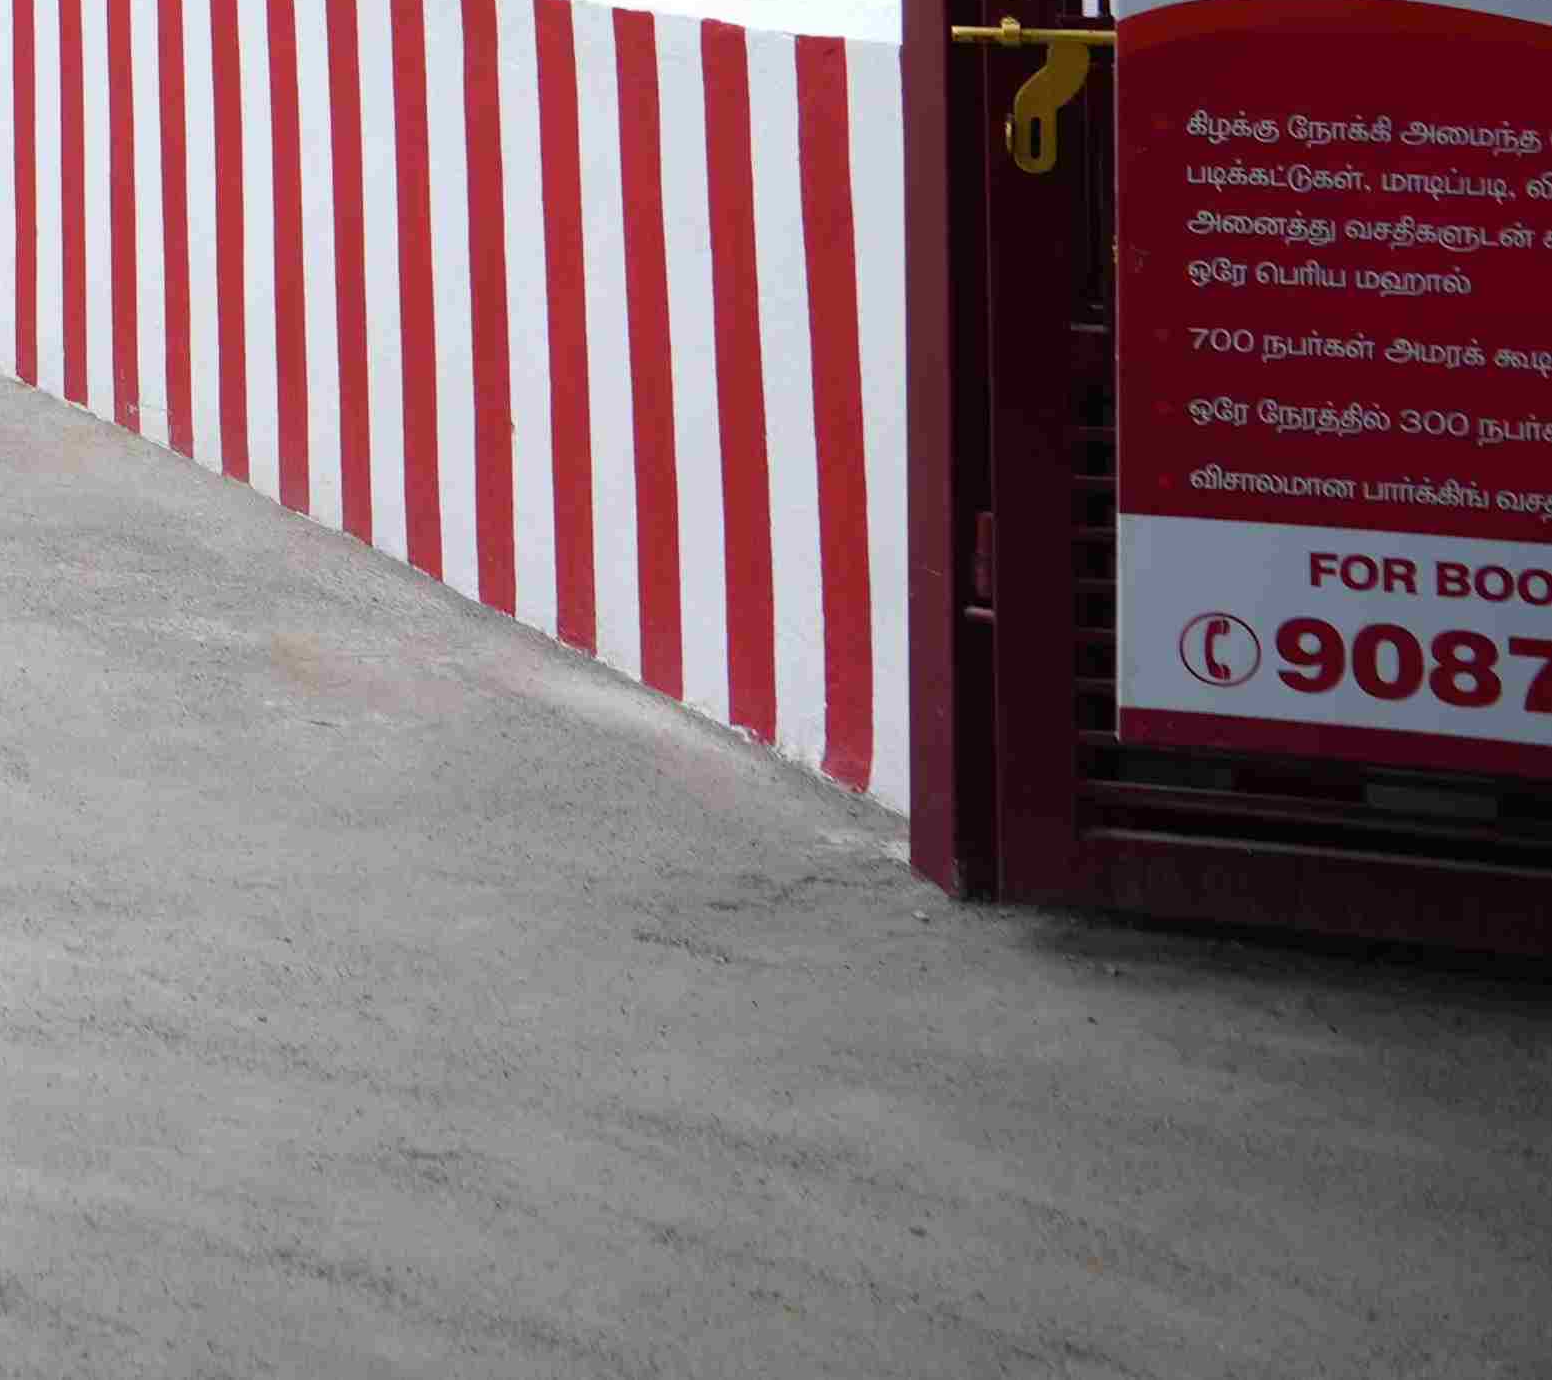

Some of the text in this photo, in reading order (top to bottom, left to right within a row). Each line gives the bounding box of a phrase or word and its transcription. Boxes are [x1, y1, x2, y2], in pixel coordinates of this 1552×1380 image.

[1186, 109, 1543, 158] கிழக்கு நோக்கி அமைந்த
[1186, 209, 1336, 246] அனைத்து
[1344, 215, 1536, 253] வசதிகளுடன்
[1187, 256, 1472, 298] ஒரே பெரிய மஹால்
[1188, 327, 1255, 353] 700
[1261, 329, 1376, 364] நபர்கள்
[1384, 337, 1487, 369] அமரக்
[1188, 395, 1250, 427] ஒரே
[1256, 397, 1392, 438] நேரத்தில்
[1398, 408, 1470, 437] 300
[1189, 462, 1357, 499] விசாலமான
[1362, 475, 1490, 509] பார்க்கிங்
[1308, 551, 1552, 607] FOR BOO
[1274, 616, 1552, 713] 9087
